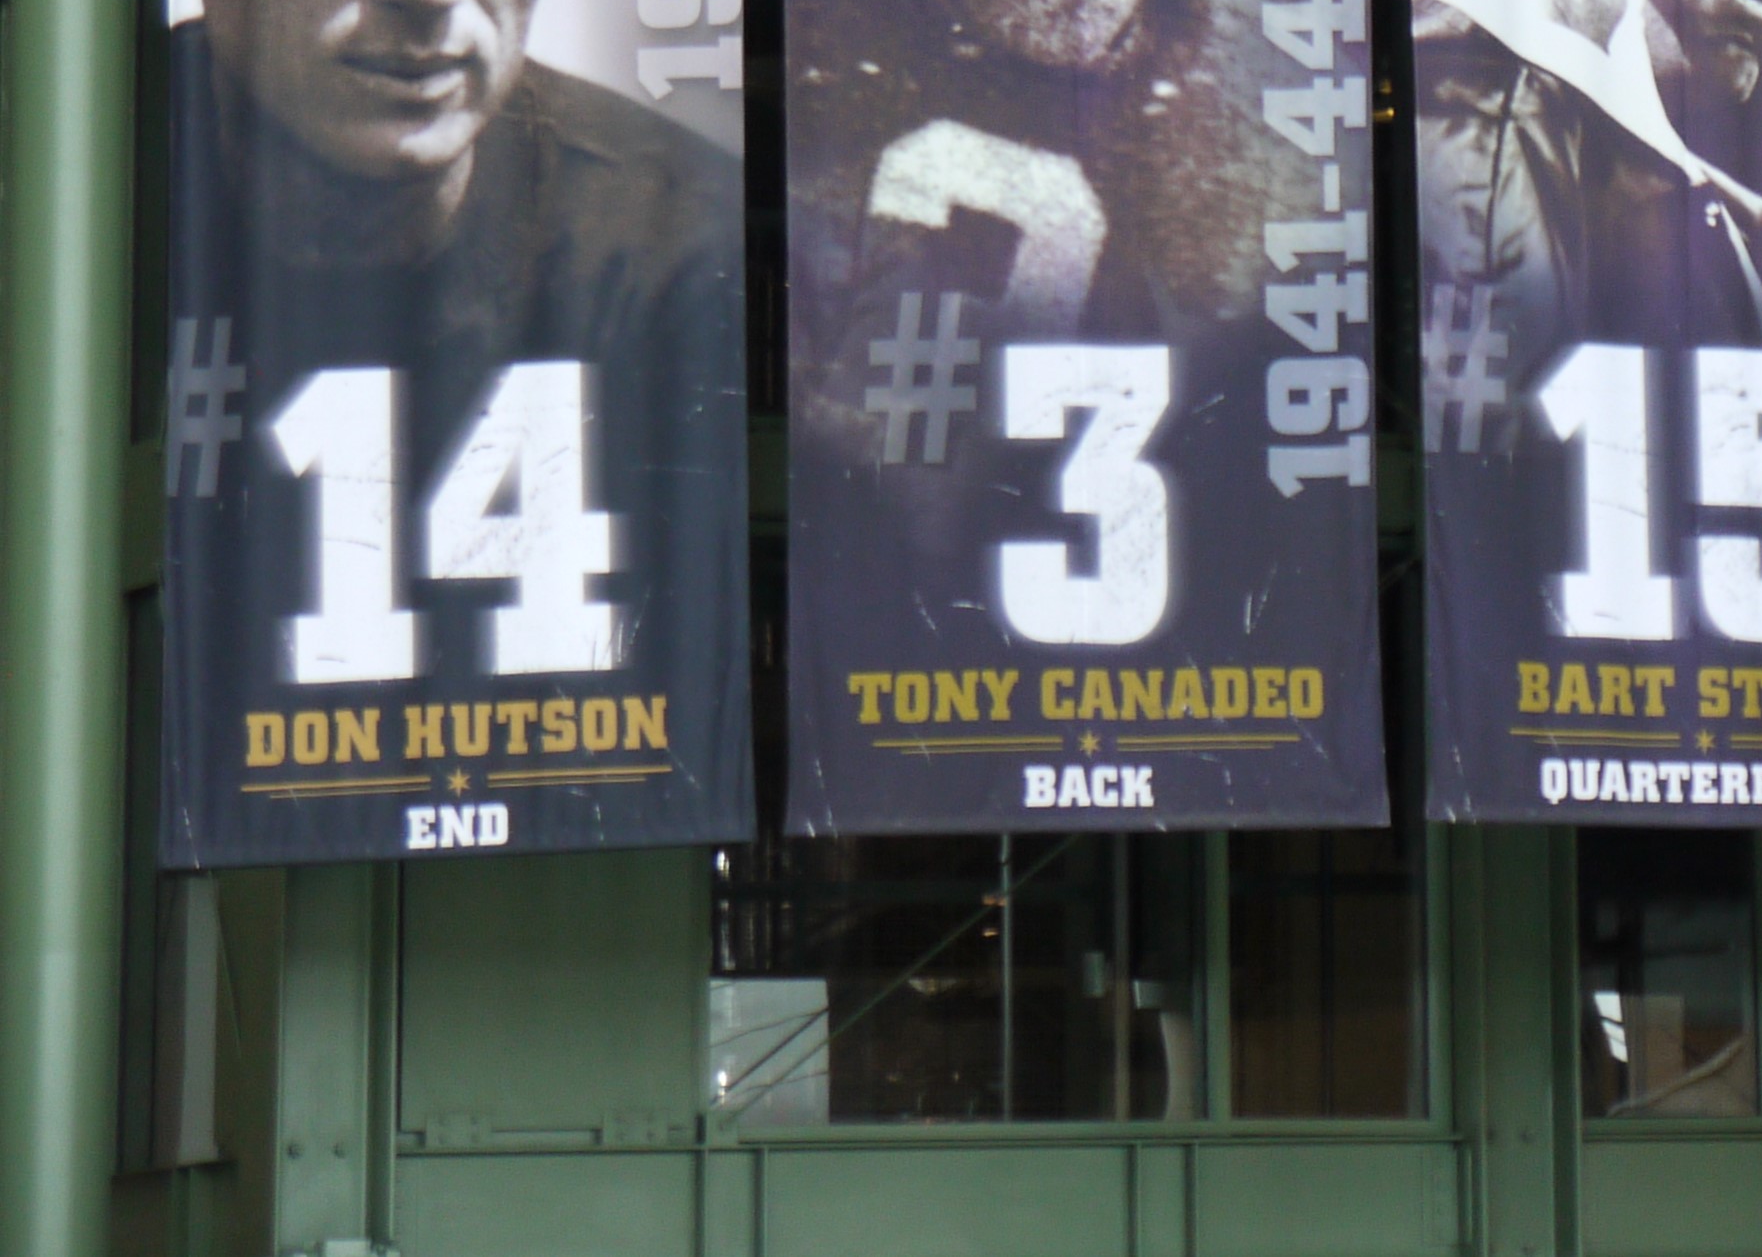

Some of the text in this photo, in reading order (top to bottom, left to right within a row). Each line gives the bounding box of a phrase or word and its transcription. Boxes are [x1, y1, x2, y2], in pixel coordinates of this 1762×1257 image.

[272, 360, 616, 685] 14
[1000, 343, 1170, 645] 3
[848, 667, 1326, 725] TONY CANADEO
[1517, 662, 1676, 715] BART
[245, 695, 669, 767] DON HUTSON
[1024, 765, 1155, 809] BACK
[407, 804, 510, 850] END
